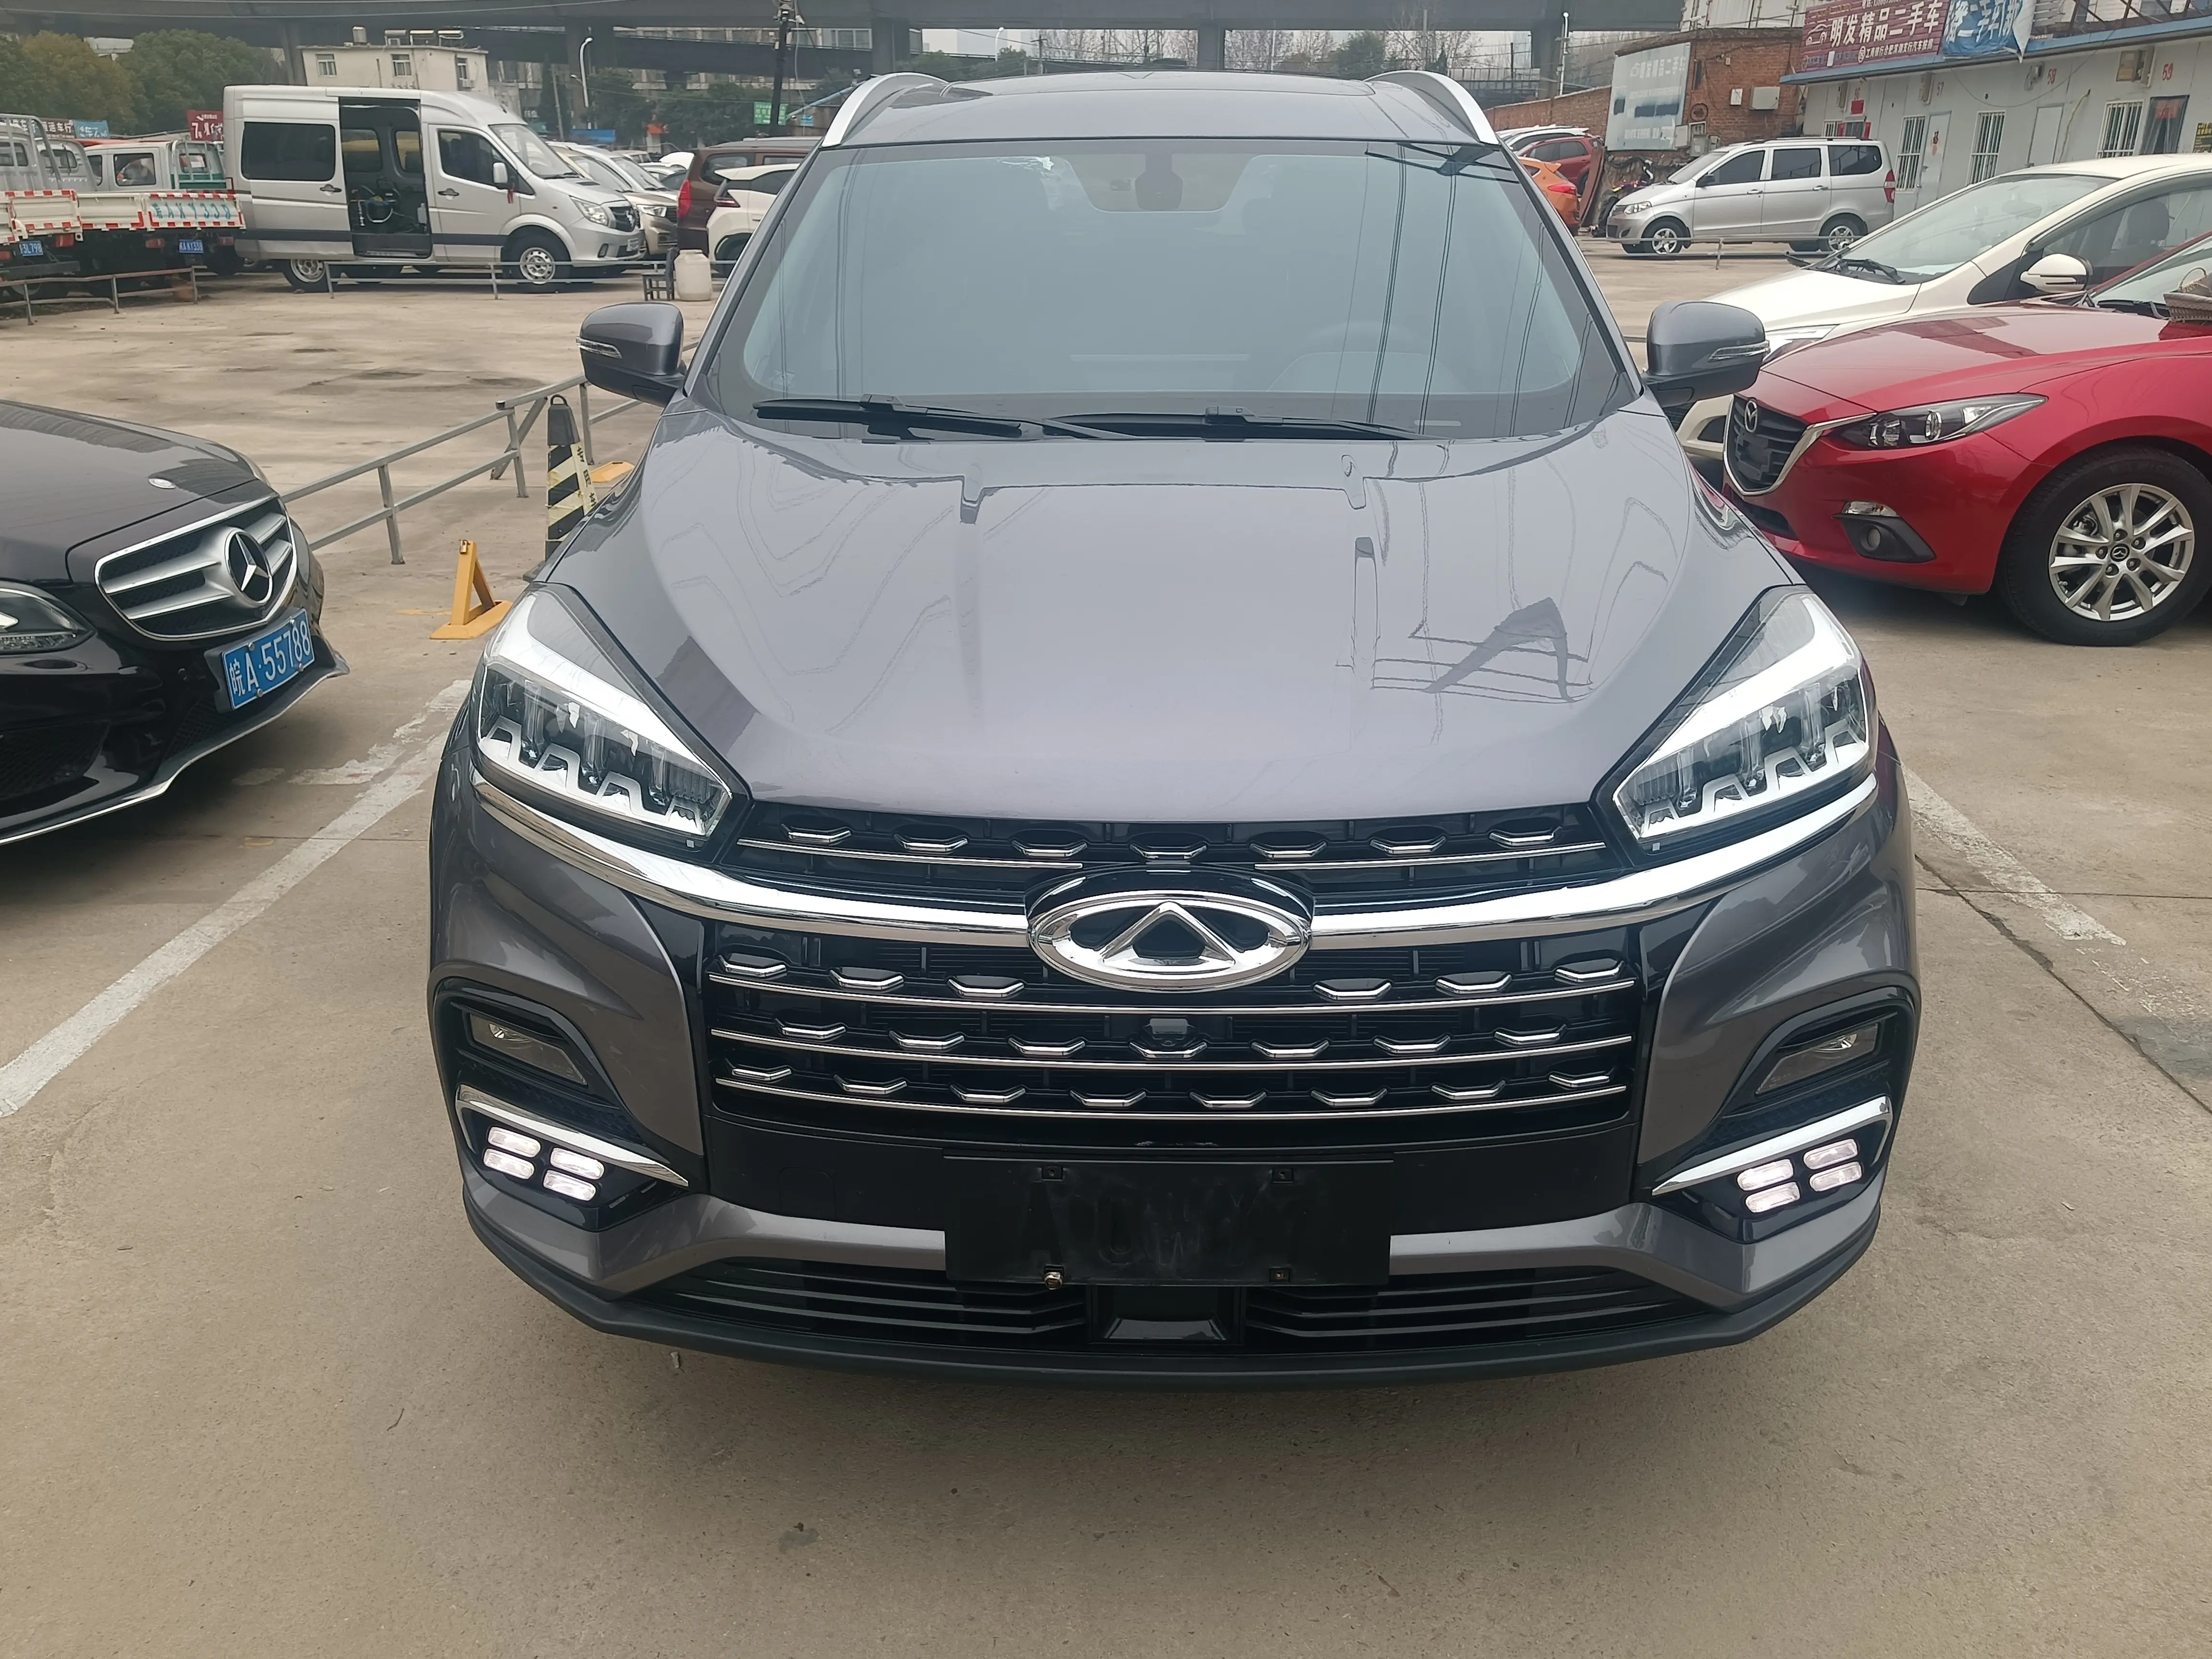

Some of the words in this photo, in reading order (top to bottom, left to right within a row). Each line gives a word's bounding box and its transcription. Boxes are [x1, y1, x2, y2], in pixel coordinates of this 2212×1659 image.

[1830, 0, 1943, 48] 明发精品二手车
[229, 620, 311, 697] 皖A·55788
